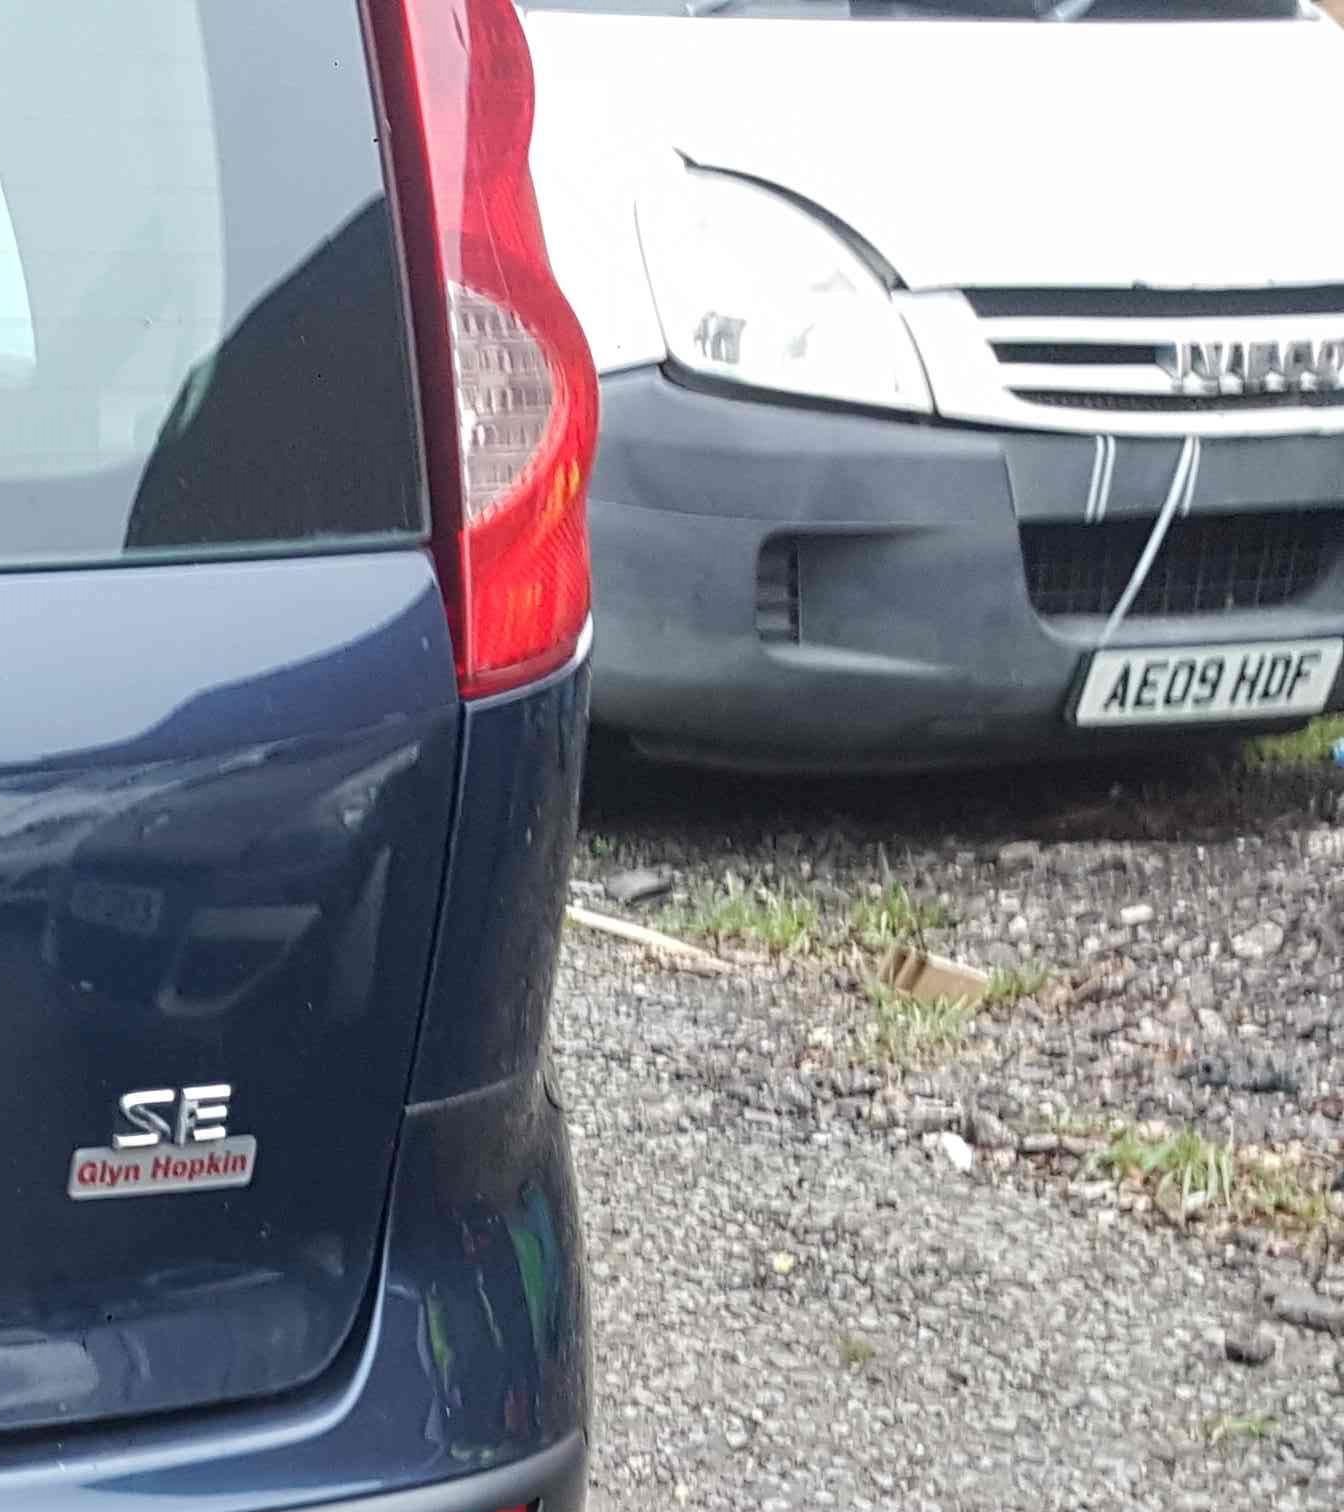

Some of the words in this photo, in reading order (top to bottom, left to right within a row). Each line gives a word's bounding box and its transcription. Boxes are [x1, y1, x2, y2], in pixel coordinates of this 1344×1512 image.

[1104, 656, 1226, 711] AE09
[1230, 651, 1322, 703] HDF
[113, 1084, 232, 1149] SE
[78, 1160, 141, 1187] Glyn
[151, 1152, 247, 1181] Hopkin
